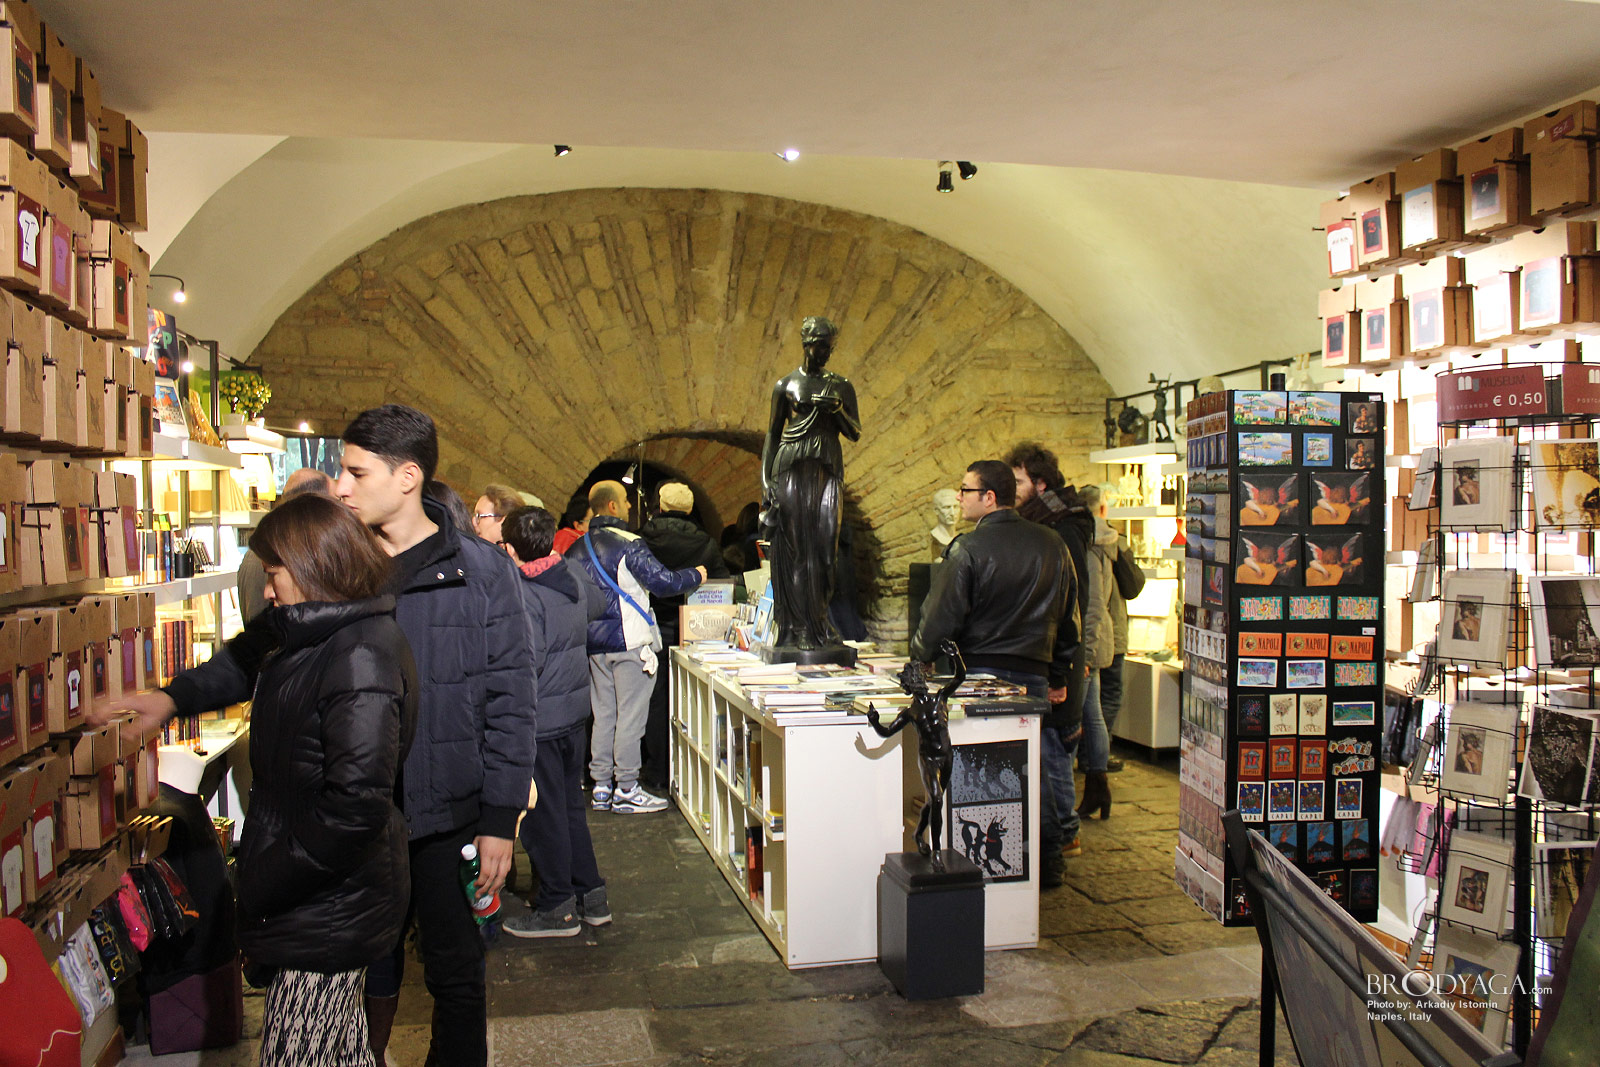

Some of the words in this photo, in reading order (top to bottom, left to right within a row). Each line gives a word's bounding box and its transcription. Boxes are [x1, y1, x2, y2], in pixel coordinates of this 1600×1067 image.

[1481, 374, 1526, 388] MUSEUM
[1508, 392, 1542, 406] 0,50
[1258, 638, 1279, 650] NAPOLI
[1305, 638, 1327, 651] NAPOLI
[1350, 641, 1371, 654] NAPOLI
